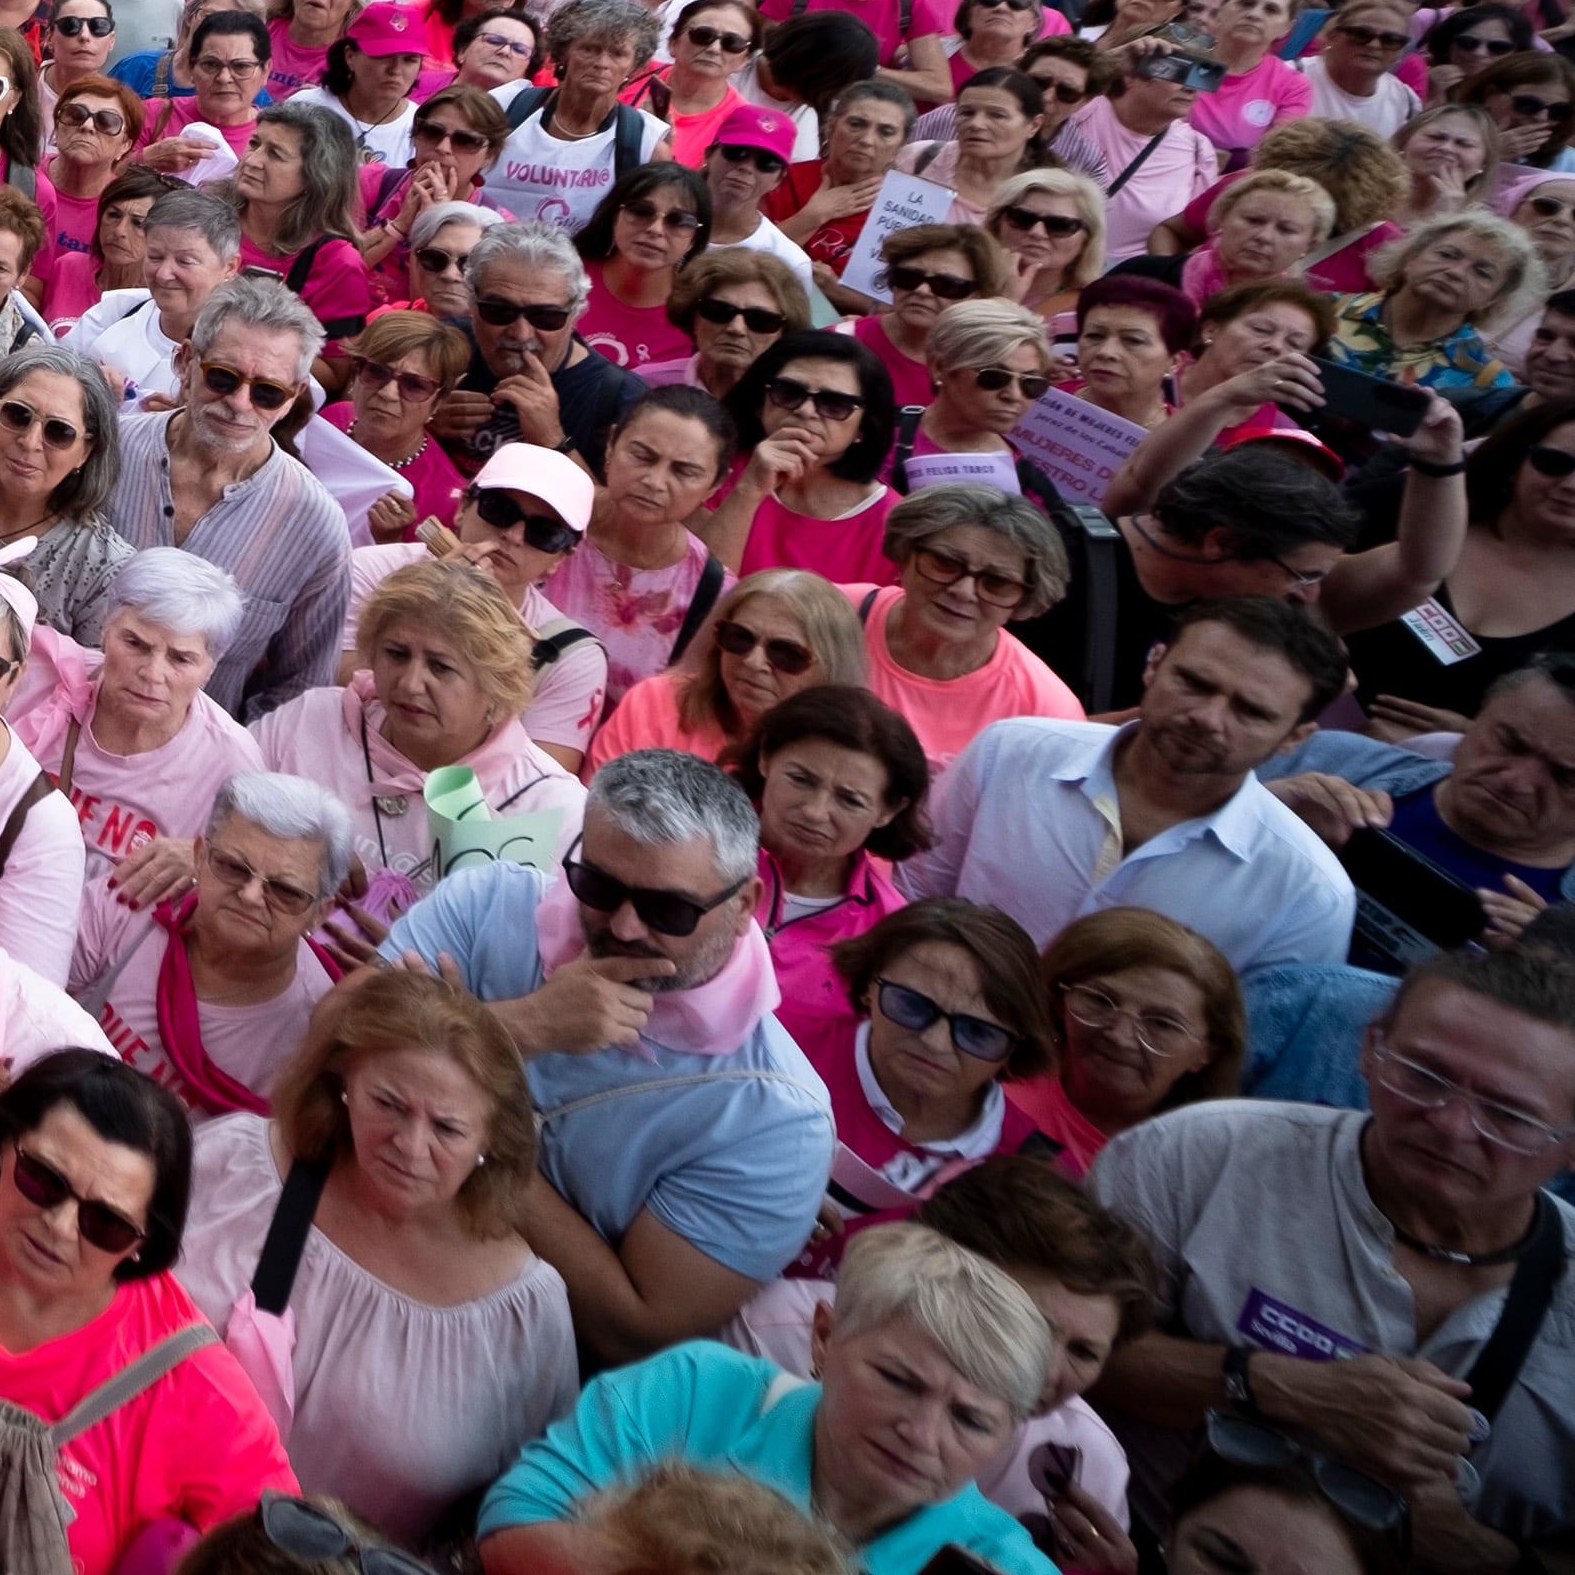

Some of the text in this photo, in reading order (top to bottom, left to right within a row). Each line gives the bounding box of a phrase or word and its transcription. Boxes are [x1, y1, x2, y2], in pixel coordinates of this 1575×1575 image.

[907, 191, 924, 205] LA
[1079, 412, 1123, 441] MUJERES
[1260, 1304, 1334, 1355] CCOO
